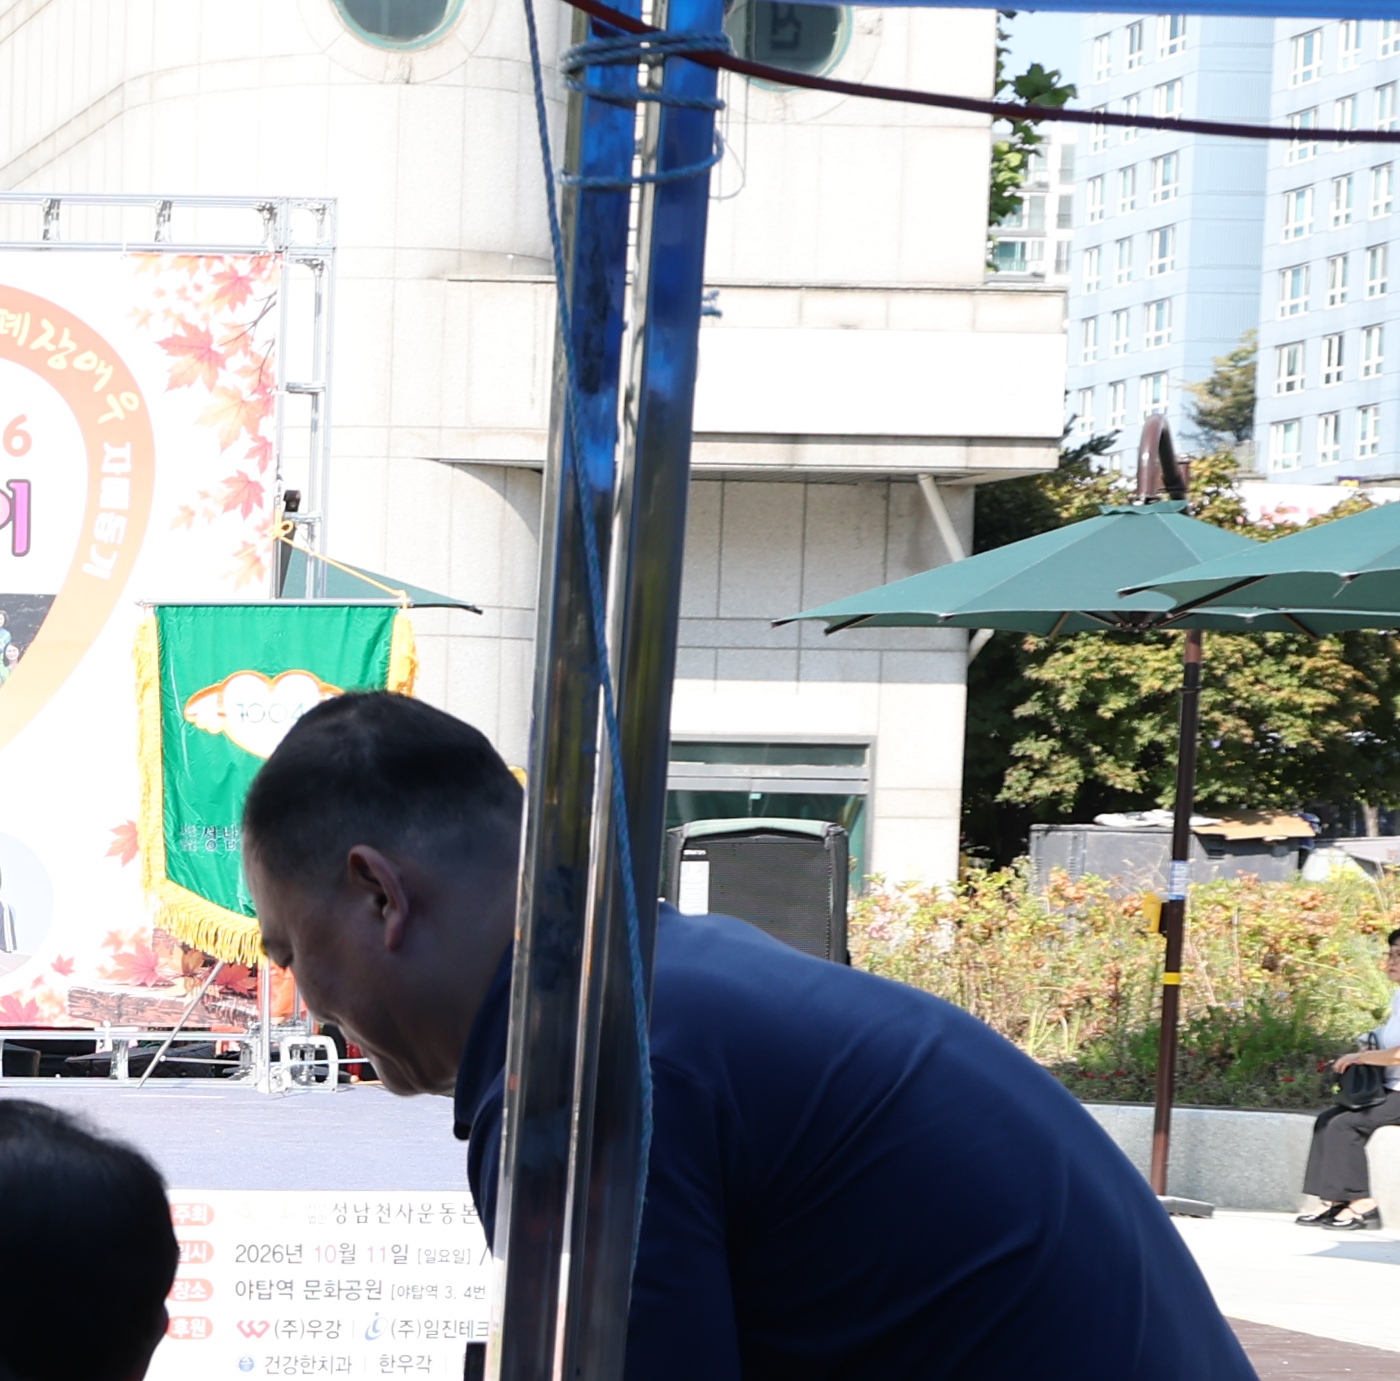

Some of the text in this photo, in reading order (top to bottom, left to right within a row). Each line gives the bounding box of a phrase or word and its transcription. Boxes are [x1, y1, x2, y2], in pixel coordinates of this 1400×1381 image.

[235, 1244, 302, 1264] 2026년
[315, 1243, 355, 1264] 10월
[367, 1244, 408, 1264] 11일
[418, 1248, 470, 1265] [일요일]
[173, 1280, 207, 1300] 장소
[235, 1279, 293, 1300] 야탑역
[303, 1279, 382, 1301] 문화공원
[391, 1284, 438, 1300] [야탑역
[463, 1286, 486, 1301] 4번
[172, 1318, 207, 1338] 후원
[275, 1318, 489, 1340] (주)우강 (주)일진테크
[265, 1354, 432, 1375] 건강한치과 한우각
